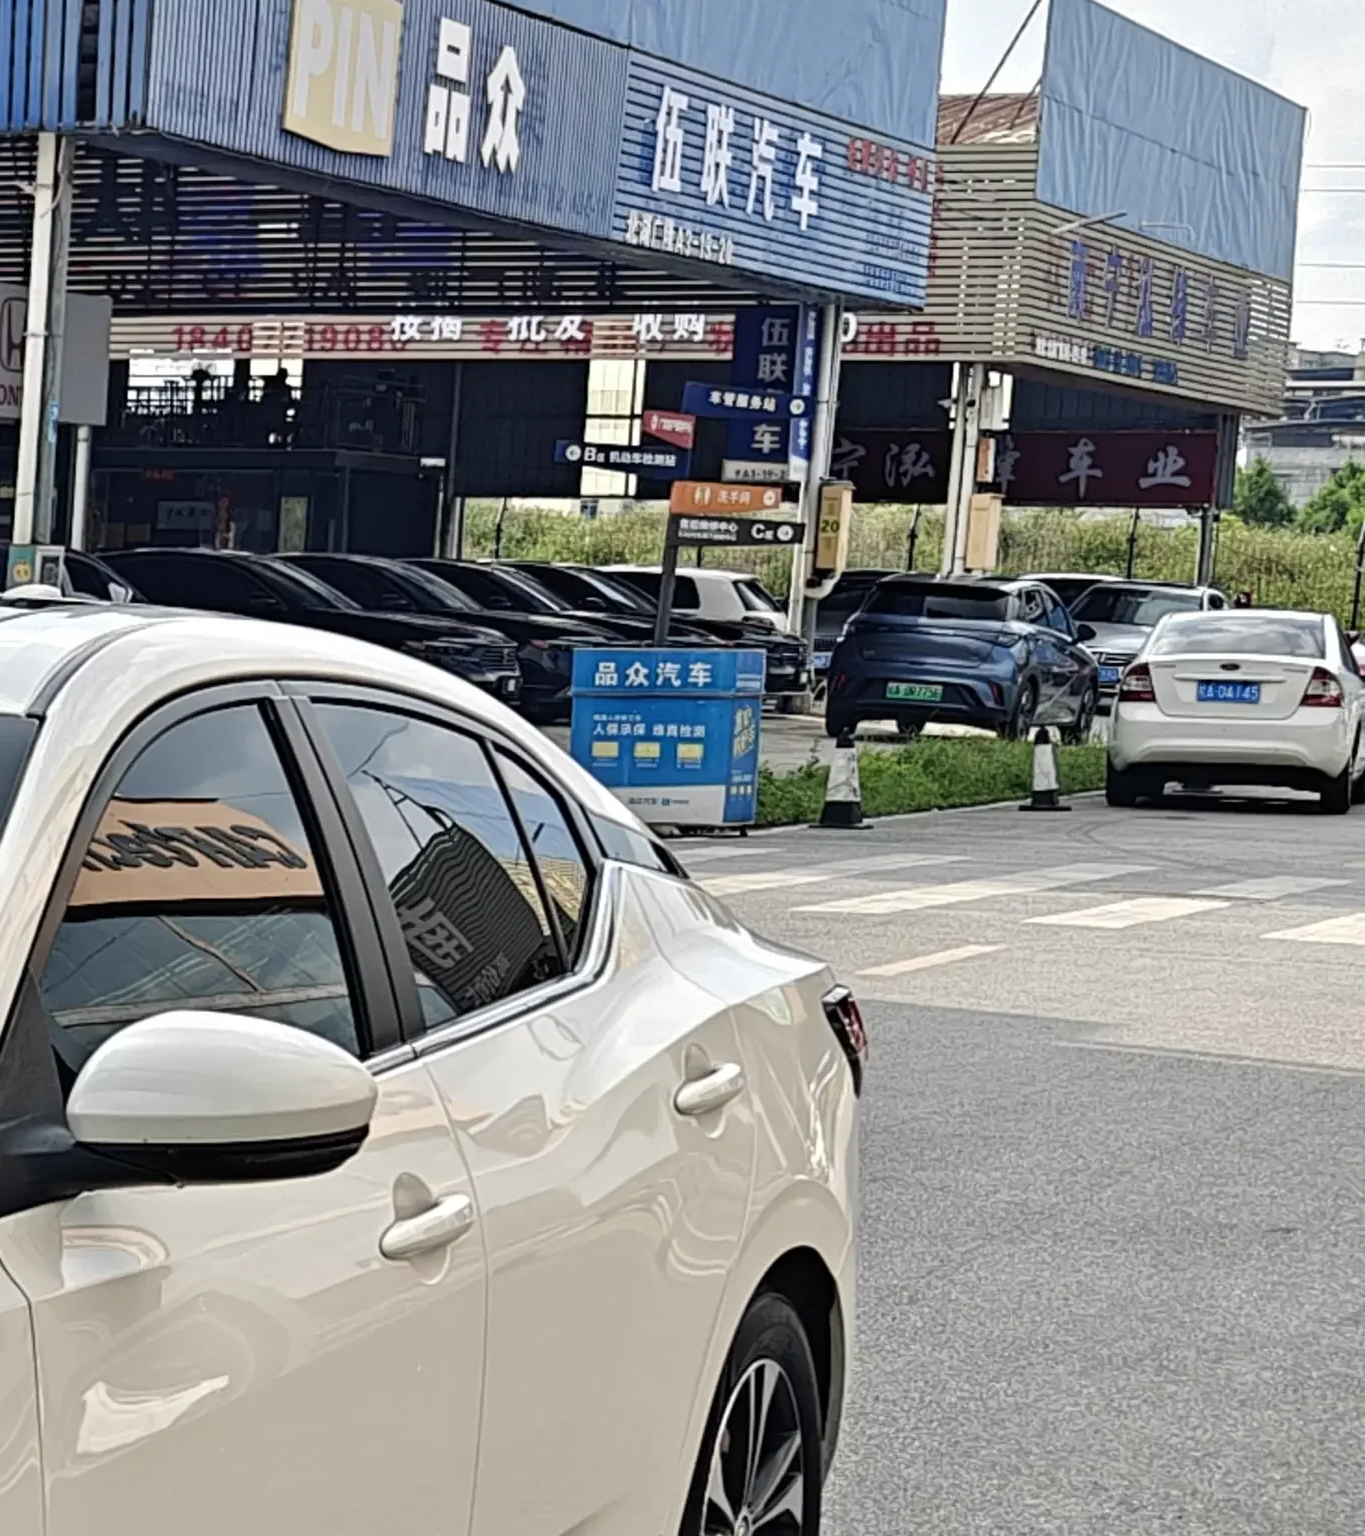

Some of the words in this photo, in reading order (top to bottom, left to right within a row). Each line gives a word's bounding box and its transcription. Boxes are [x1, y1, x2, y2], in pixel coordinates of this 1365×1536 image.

[293, 0, 395, 140] PIN
[424, 16, 526, 174] 品众
[651, 86, 823, 232] 伍联汽车
[750, 316, 791, 454] 伍联车
[820, 519, 840, 532] 20
[594, 661, 713, 688] 品众汽车
